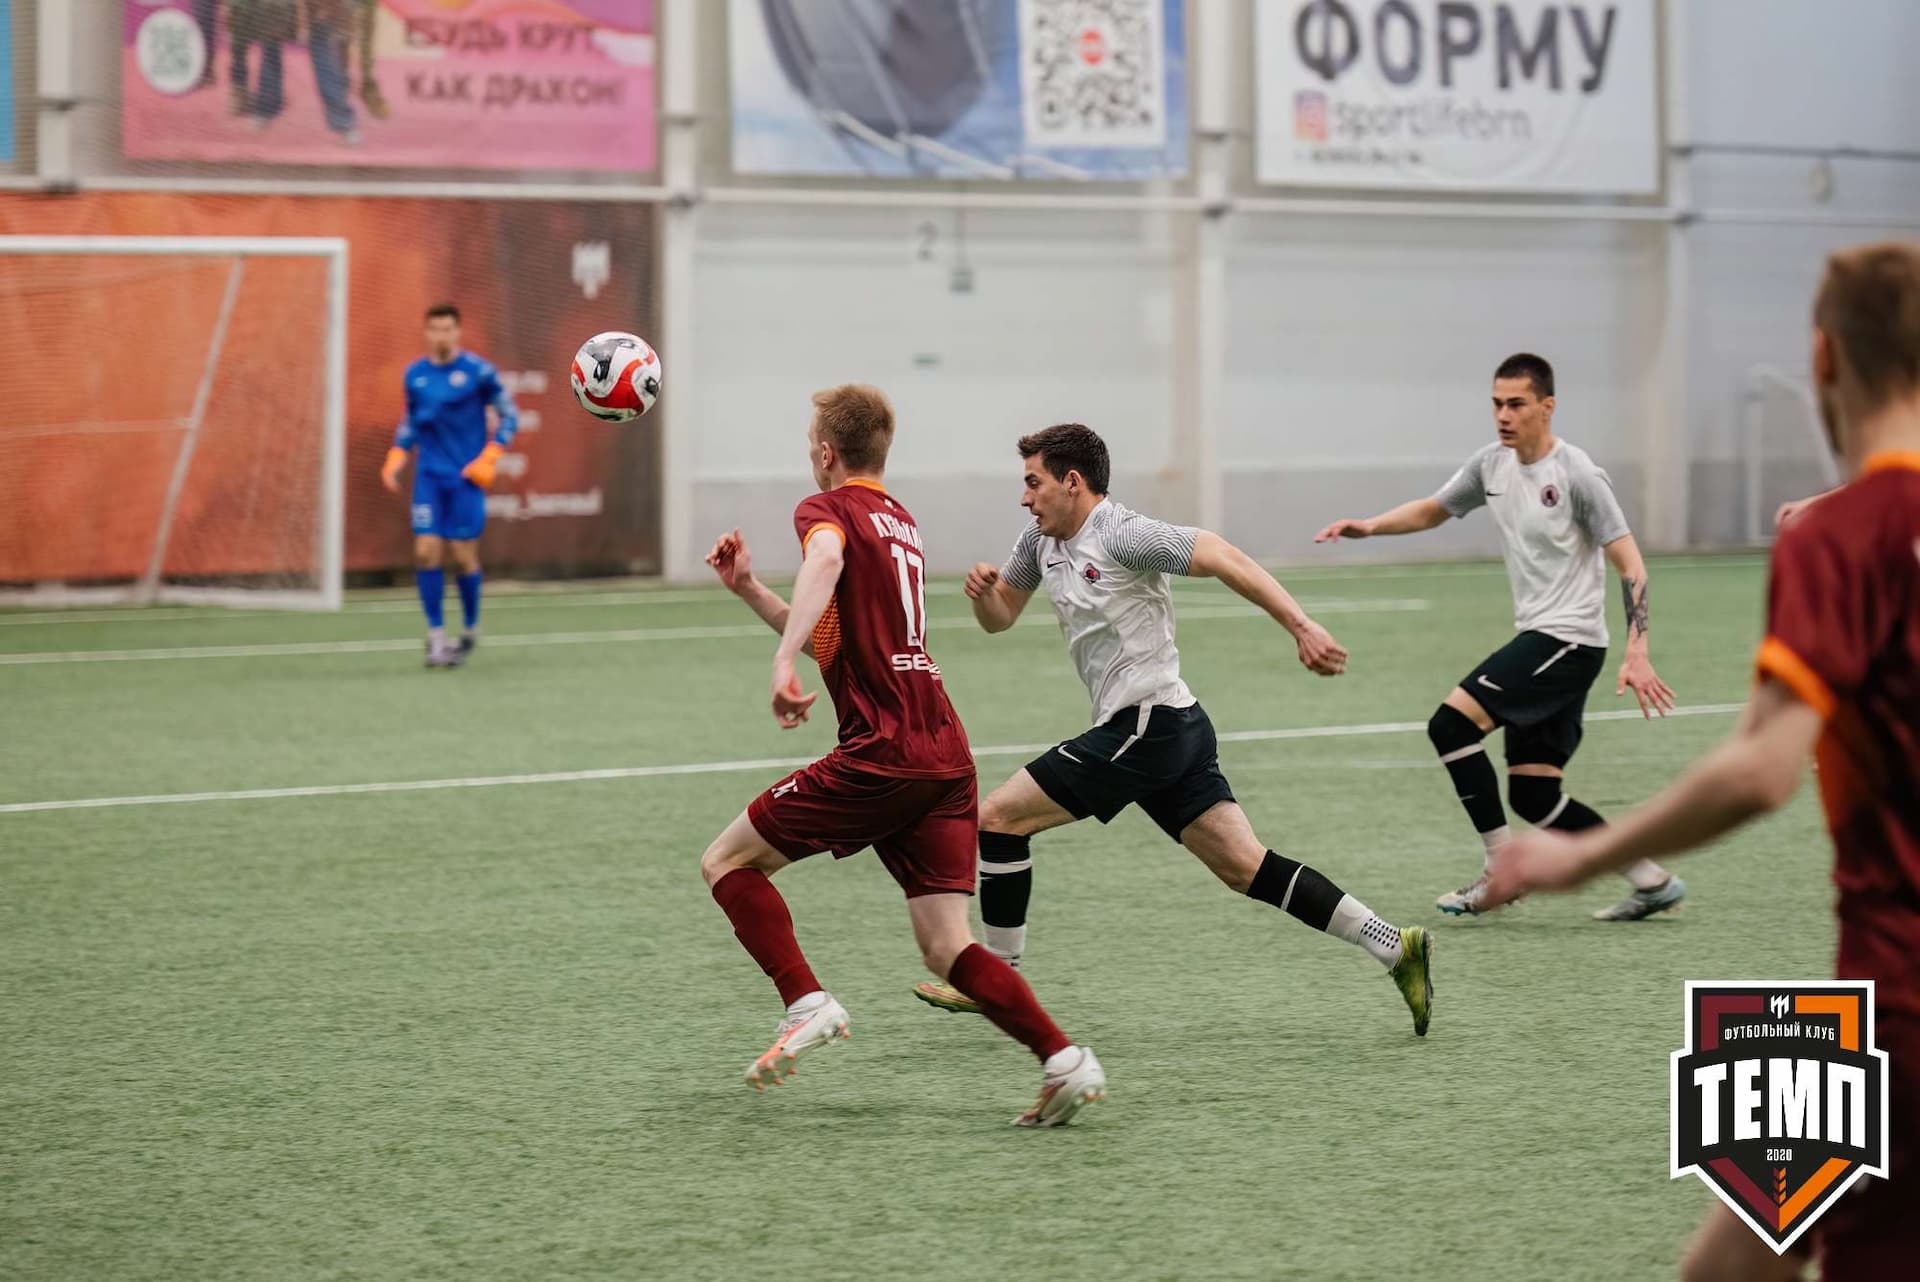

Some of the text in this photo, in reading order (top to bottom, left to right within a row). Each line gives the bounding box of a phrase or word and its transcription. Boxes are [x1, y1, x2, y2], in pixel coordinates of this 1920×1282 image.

[404, 72, 474, 101] КАК
[1294, 0, 1617, 93] ФОРМУ
[890, 542, 925, 653] 17
